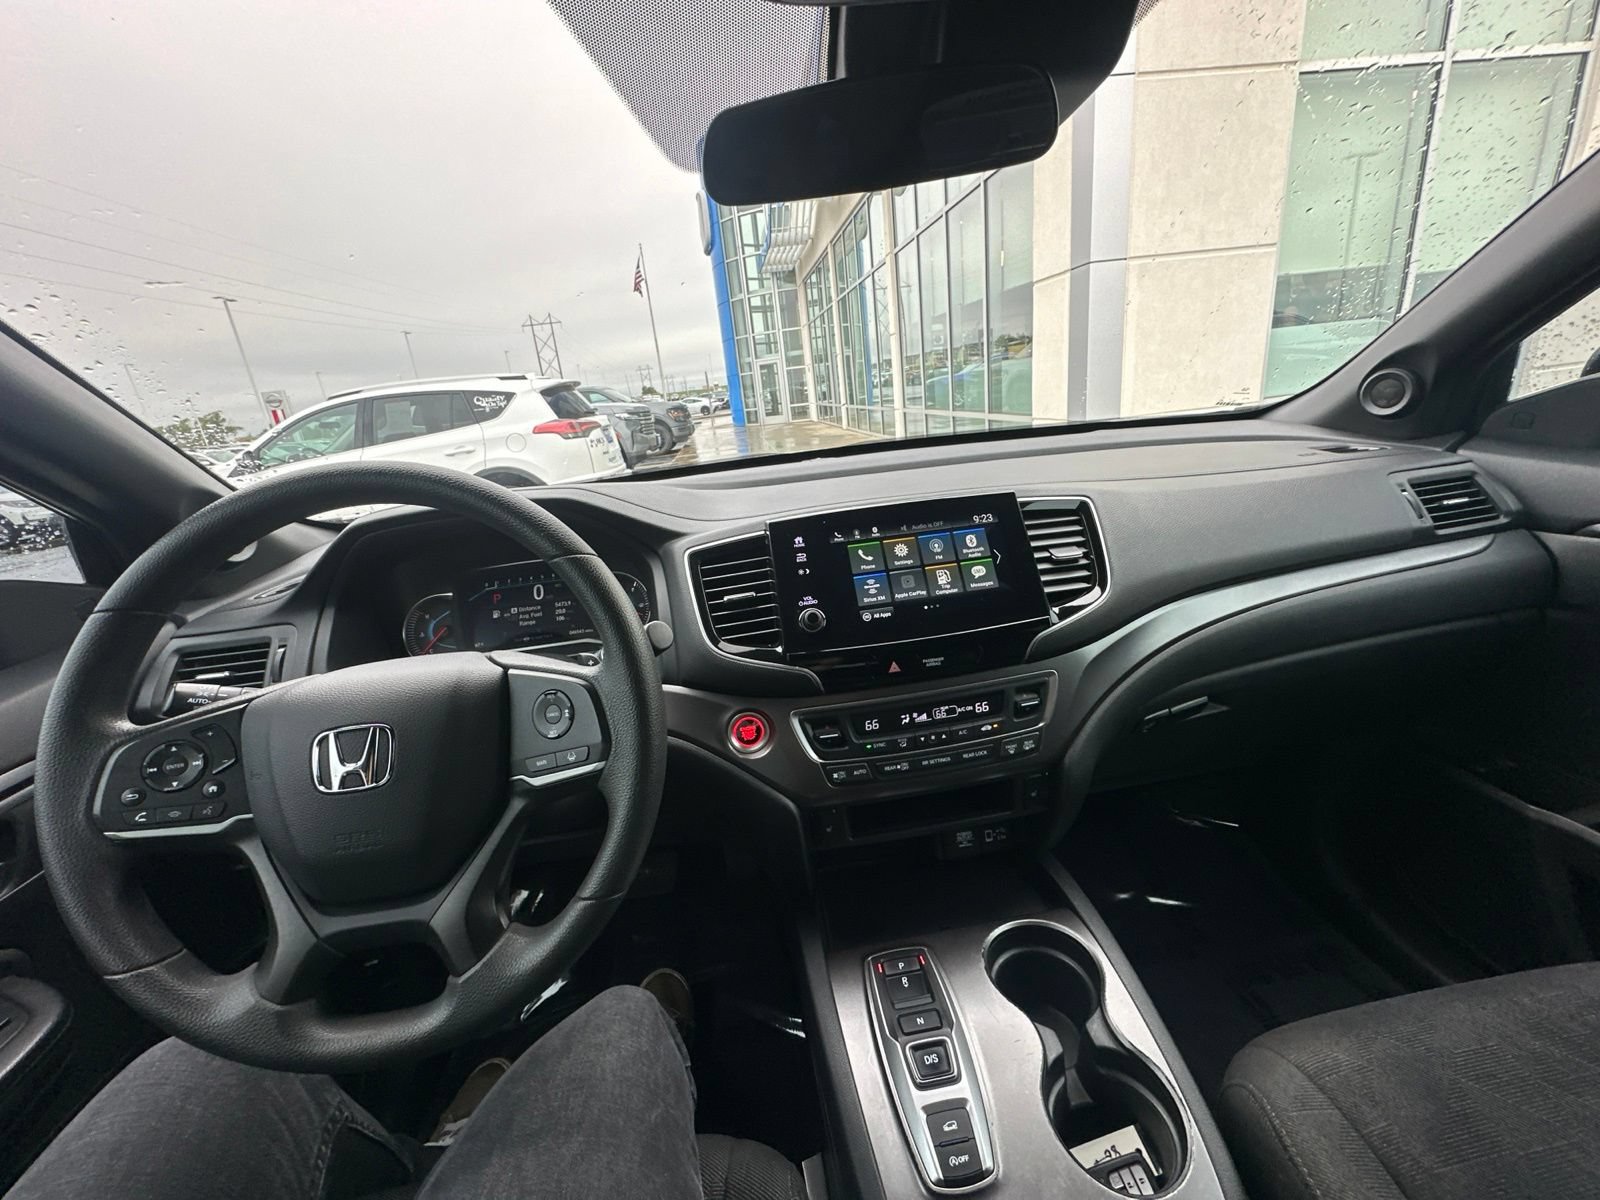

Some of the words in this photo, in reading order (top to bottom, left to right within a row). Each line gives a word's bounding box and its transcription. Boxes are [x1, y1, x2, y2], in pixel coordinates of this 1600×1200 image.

[972, 513, 994, 524] 9:23
[533, 584, 544, 600] 0
[894, 592, 909, 600] Apple
[493, 593, 501, 604] P
[518, 605, 541, 613] Distance
[975, 701, 990, 713] 66
[935, 709, 947, 719] 66
[865, 719, 880, 731] 66
[166, 762, 185, 770] ENTER
[902, 976, 908, 985] R
[917, 1017, 925, 1025] N
[924, 1053, 939, 1064] D/S
[957, 1154, 969, 1163] OFF
